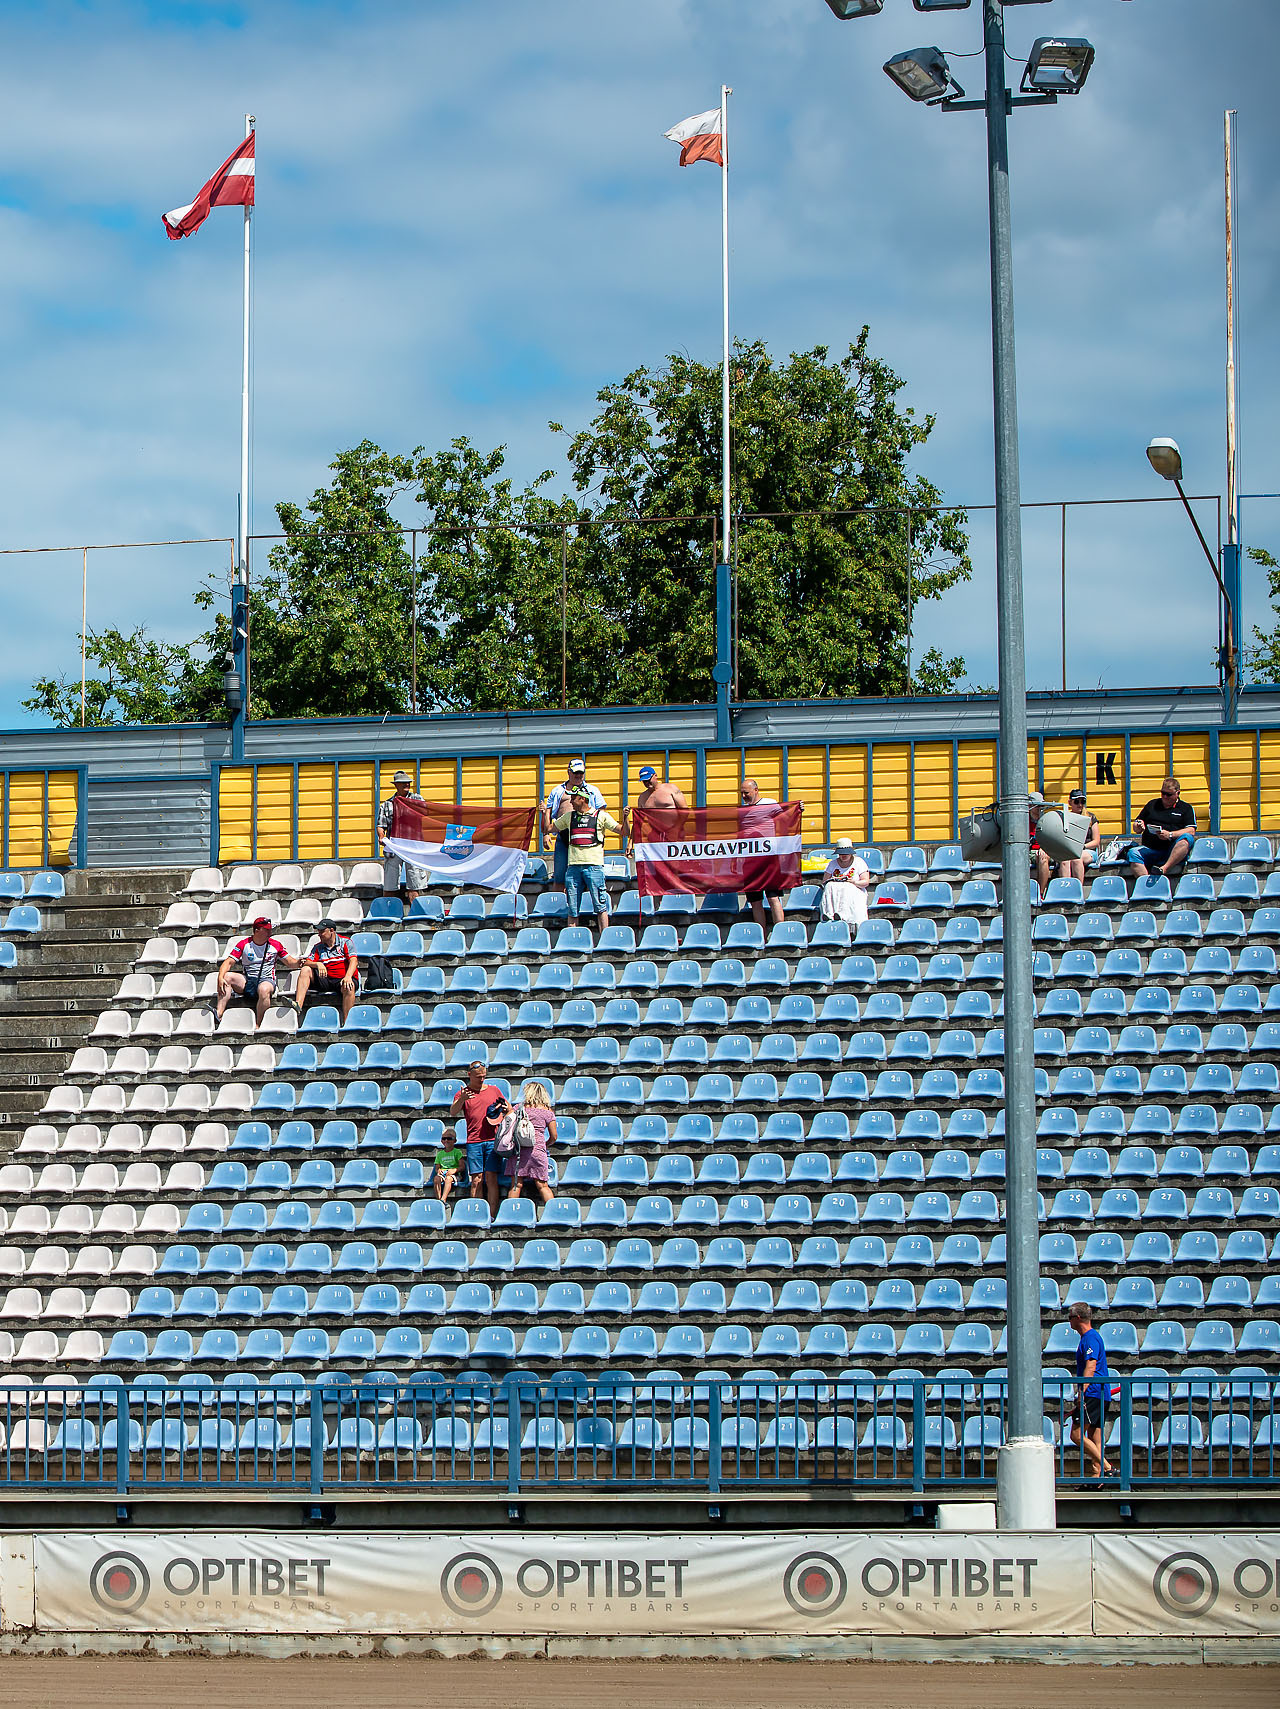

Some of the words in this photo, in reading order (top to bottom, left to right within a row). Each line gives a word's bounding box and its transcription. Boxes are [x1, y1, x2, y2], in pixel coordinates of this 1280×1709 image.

[1096, 753, 1116, 785] K
[667, 838, 772, 859] DAUGAVPILS
[164, 1558, 331, 1595] OPTIBET
[517, 1559, 688, 1598] OPTIBET
[862, 1557, 1038, 1598] OPTIBET
[1234, 1558, 1280, 1598] O
[164, 1600, 256, 1610] SPORTA
[273, 1598, 331, 1611] BĀRS
[517, 1601, 610, 1613] SPORTA
[630, 1599, 689, 1613] BĀRS
[862, 1602, 958, 1613] SPORTA
[977, 1599, 1038, 1613] BĀRS
